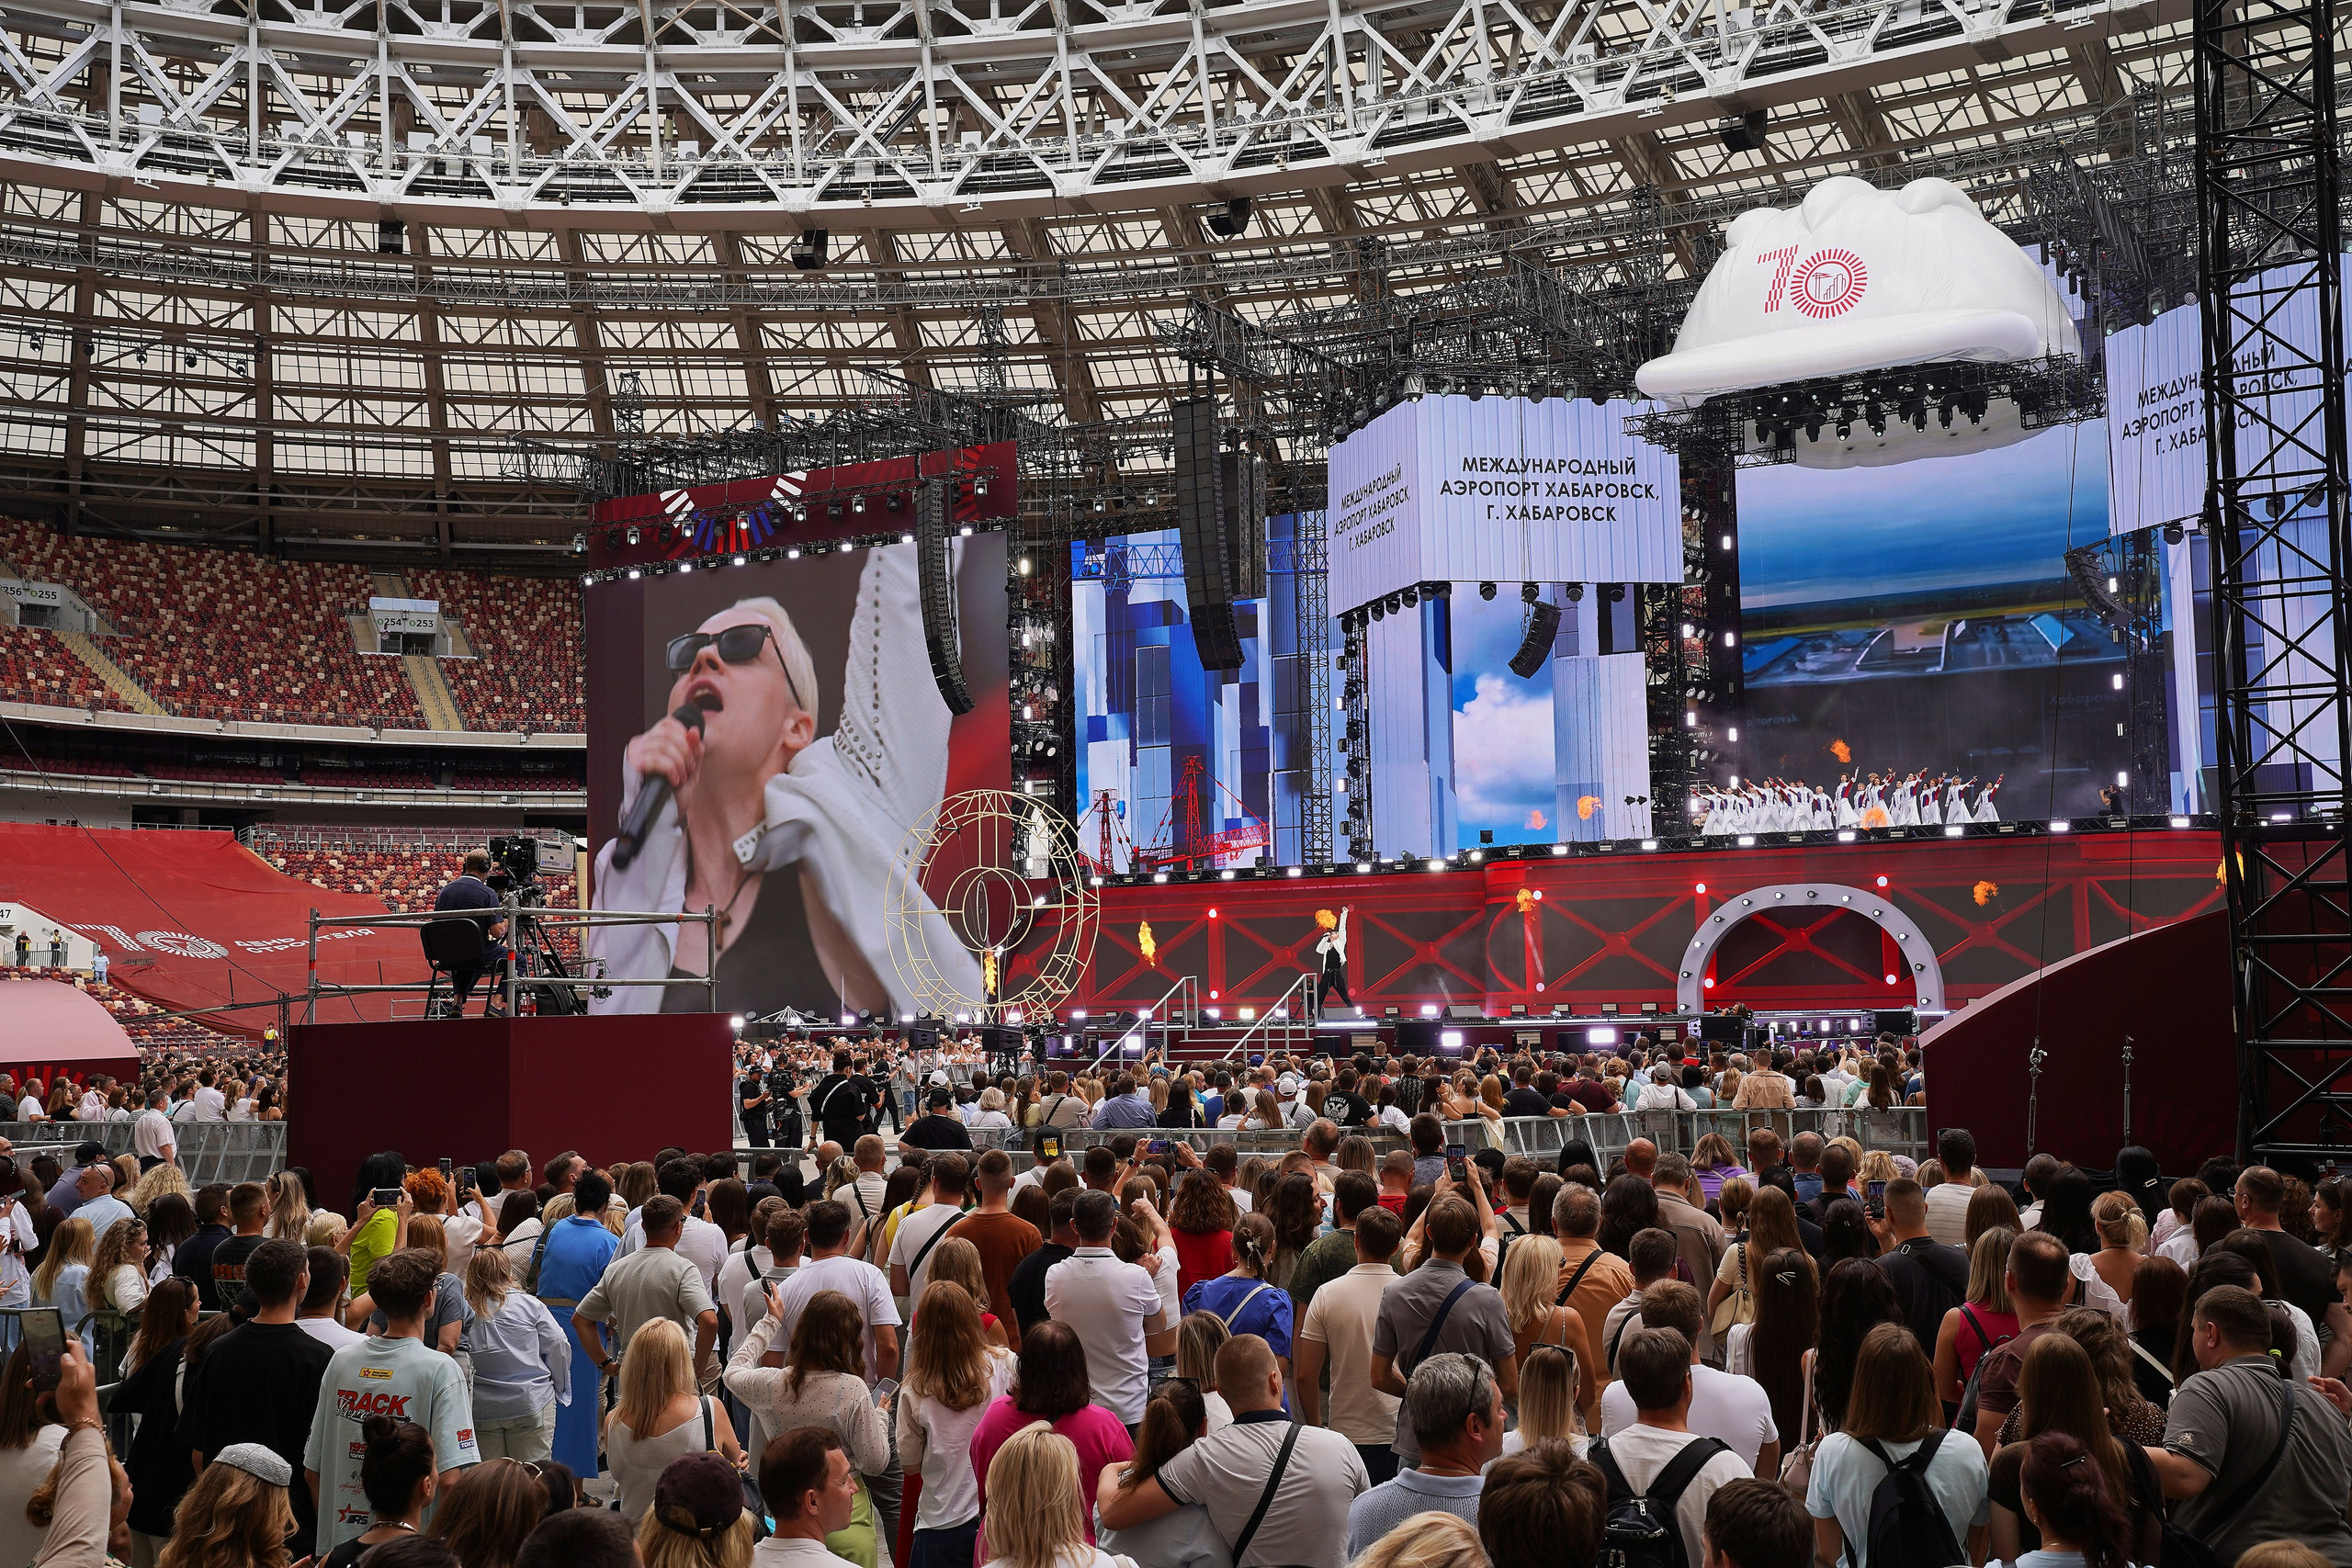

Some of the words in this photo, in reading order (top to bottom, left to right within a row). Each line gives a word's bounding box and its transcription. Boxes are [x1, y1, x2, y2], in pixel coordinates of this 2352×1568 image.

[2121, 400, 2195, 440] АЭРОПОРТ
[2155, 438, 2165, 456] Г.
[1462, 456, 1636, 476] МЕЖДУНАРОДНЫЙ
[1341, 462, 1401, 512] МЕЖДУНАРОДНЫЙ
[1440, 479, 1540, 498] АЭРОПОРТ
[1544, 481, 1659, 501] ХАБАРОВСК,
[1334, 507, 1366, 537] АЭРОПОРТ
[1368, 485, 1410, 520] ХАБАРОВСК,
[1487, 505, 1499, 521] Г.
[1505, 505, 1617, 522] ХАБАРОВСК
[1349, 536, 1354, 552] Г.
[1355, 516, 1395, 549] ХАБАРОВСК
[3, 586, 22, 596] 256
[38, 590, 57, 600] 255
[384, 617, 402, 626] 254
[416, 619, 434, 627] 253
[0, 909, 11, 919] 47
[233, 937, 296, 947] ДЕНЬ
[337, 1389, 413, 1416] TRACK
